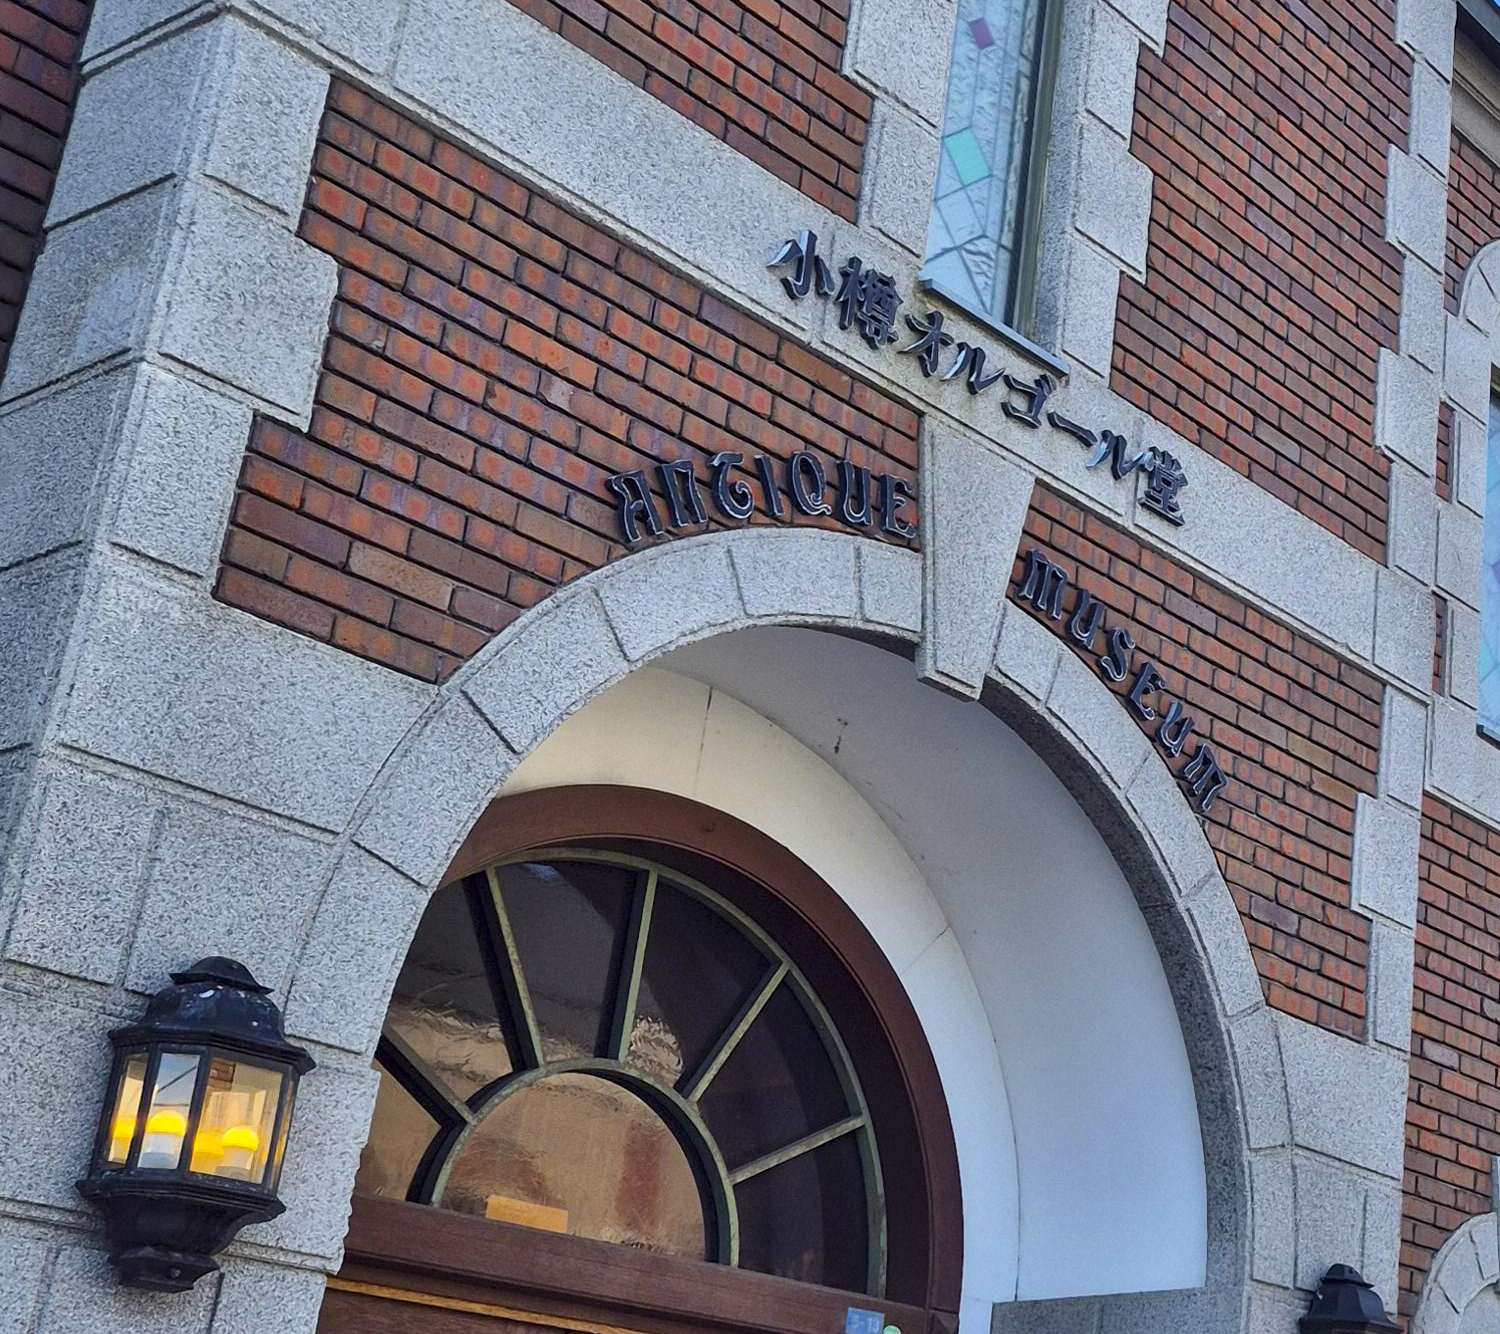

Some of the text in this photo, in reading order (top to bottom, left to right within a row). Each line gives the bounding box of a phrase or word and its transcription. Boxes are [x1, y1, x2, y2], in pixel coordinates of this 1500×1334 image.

[768, 229, 1187, 528] 小樽オルゴール堂
[606, 451, 919, 543] ANTIQUE
